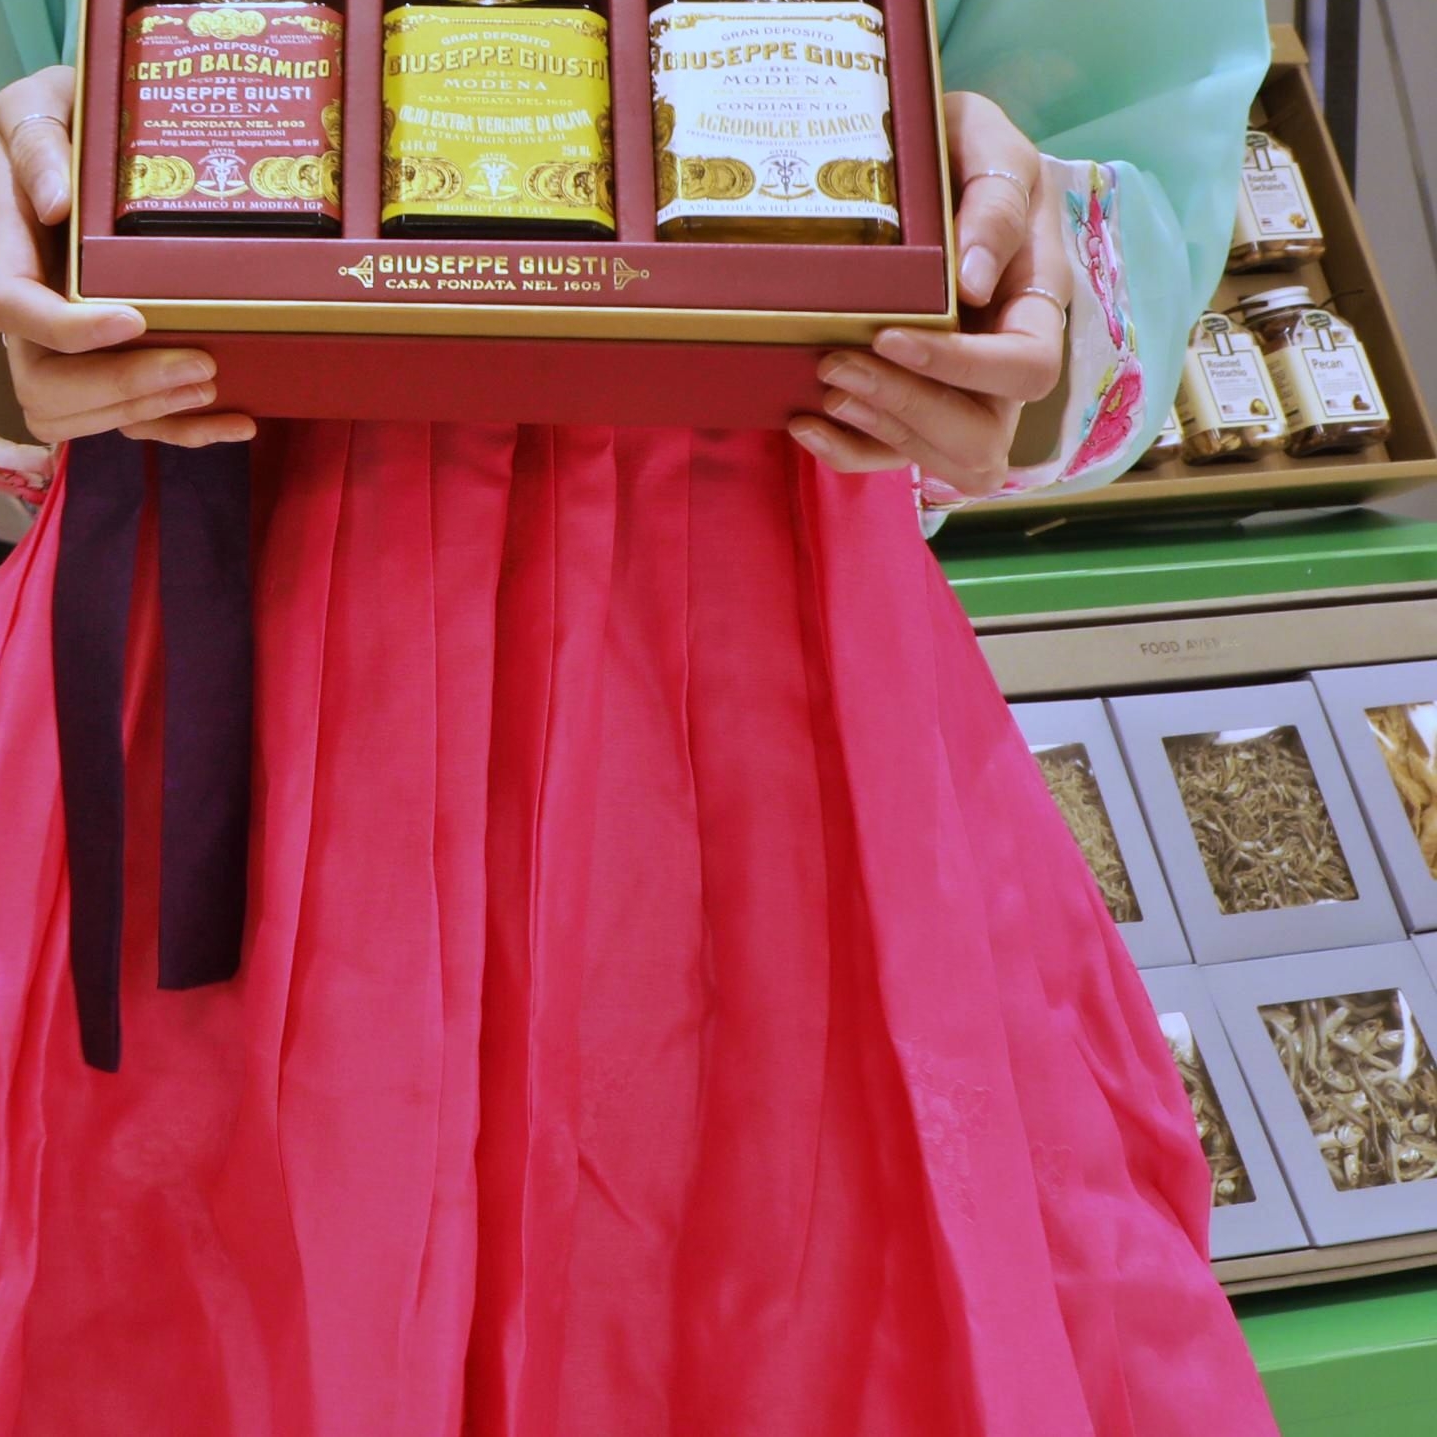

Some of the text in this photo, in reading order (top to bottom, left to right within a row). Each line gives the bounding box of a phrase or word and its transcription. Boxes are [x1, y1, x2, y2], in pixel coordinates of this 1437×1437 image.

[441, 31, 552, 48] GRAN DEPOSITO
[721, 26, 834, 42] GRAN DEPOSITO
[173, 41, 280, 57] GRAN DEPOSITO
[662, 41, 798, 71] GIUSEPPE
[129, 53, 330, 80] ACETO BALSAMICO
[389, 45, 605, 81] GIUSEPPE GIUSTI
[443, 78, 548, 91] MODENA
[722, 74, 838, 86] MODENA
[139, 86, 311, 100] GIUSEPPE GIUSTI
[169, 102, 280, 113] MODENA
[716, 102, 849, 111] CONDIMENTO
[143, 120, 179, 128] CASA
[182, 120, 242, 129] FONDATA
[246, 120, 273, 128] NEL
[399, 105, 592, 135] OLIO EXTRA VERGINE DI OLIVA
[696, 111, 876, 139] AGRODOLCE BIANCO
[161, 129, 205, 137] PREMIATA
[207, 129, 230, 137] ALLE
[422, 128, 460, 142] EXTRA
[464, 133, 505, 144] VIRGIN
[125, 200, 159, 211] ACETO
[162, 200, 229, 210] BALSAMICO
[232, 200, 246, 210] DI
[250, 200, 300, 210] MODENA
[436, 203, 554, 216] PRODUCT OF ITALY
[685, 203, 854, 213] AND SOUR WHITE GRAPES
[378, 255, 607, 276] GIUSEPPE GIUSTI
[385, 279, 601, 292] CASA FONDATA NEL 1605
[1311, 358, 1344, 370] Pecan
[1209, 368, 1248, 378] Pistachio
[1140, 640, 1180, 656] FOOD
